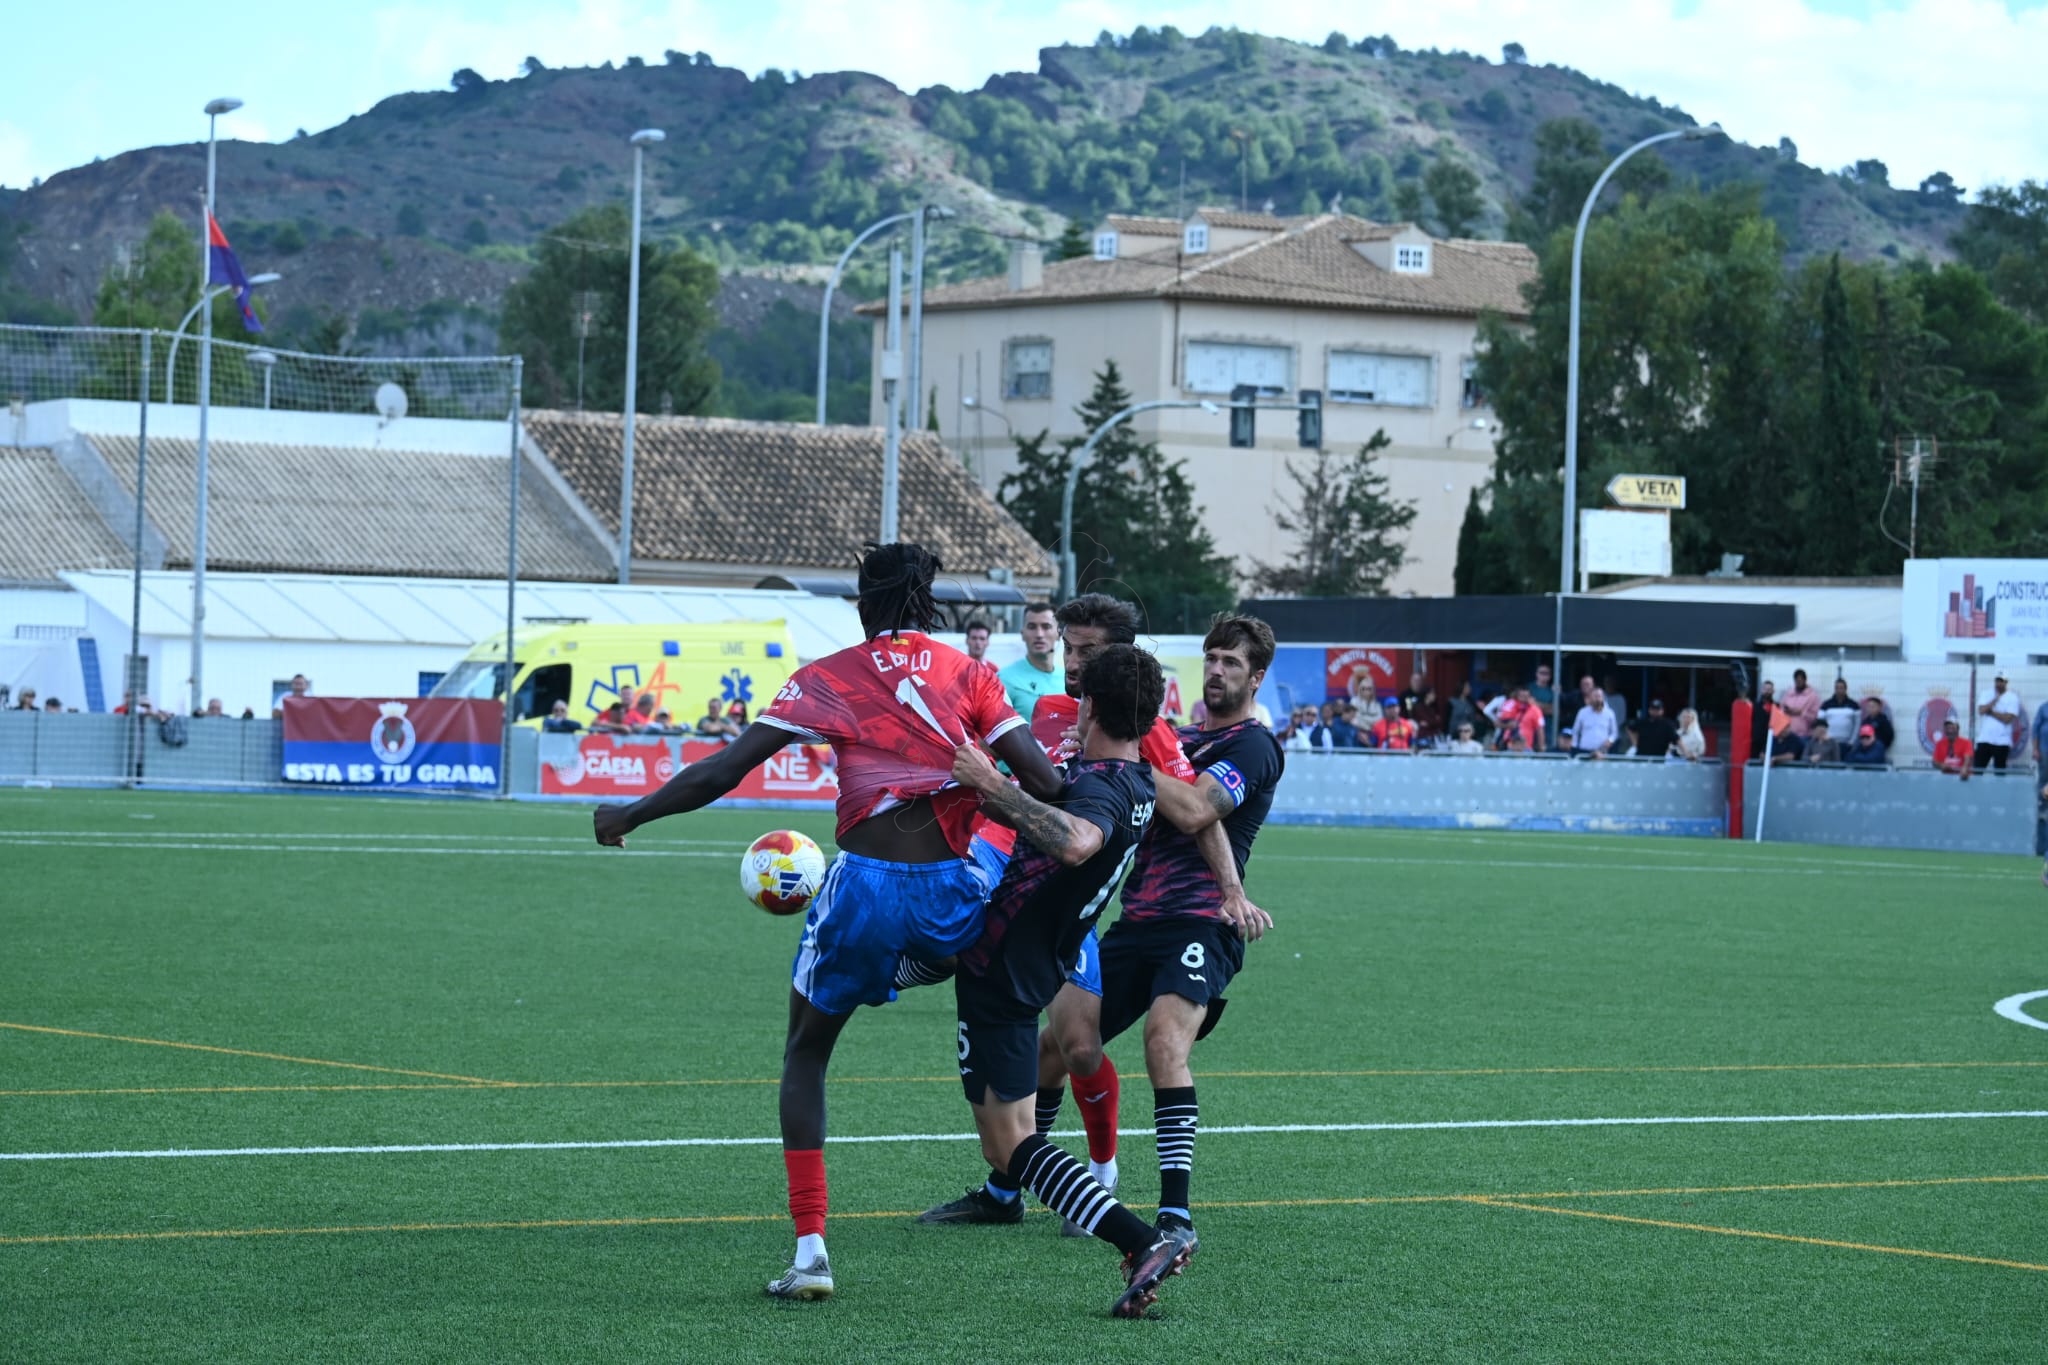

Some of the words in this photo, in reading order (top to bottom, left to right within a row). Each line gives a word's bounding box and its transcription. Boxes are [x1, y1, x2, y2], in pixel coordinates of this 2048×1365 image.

[1636, 481, 1678, 497] VETA
[1996, 580, 2048, 600] CONSTRUC
[285, 764, 343, 783] ESTA
[347, 764, 375, 783] ES
[380, 764, 412, 783] TU
[1180, 942, 1205, 969] 8
